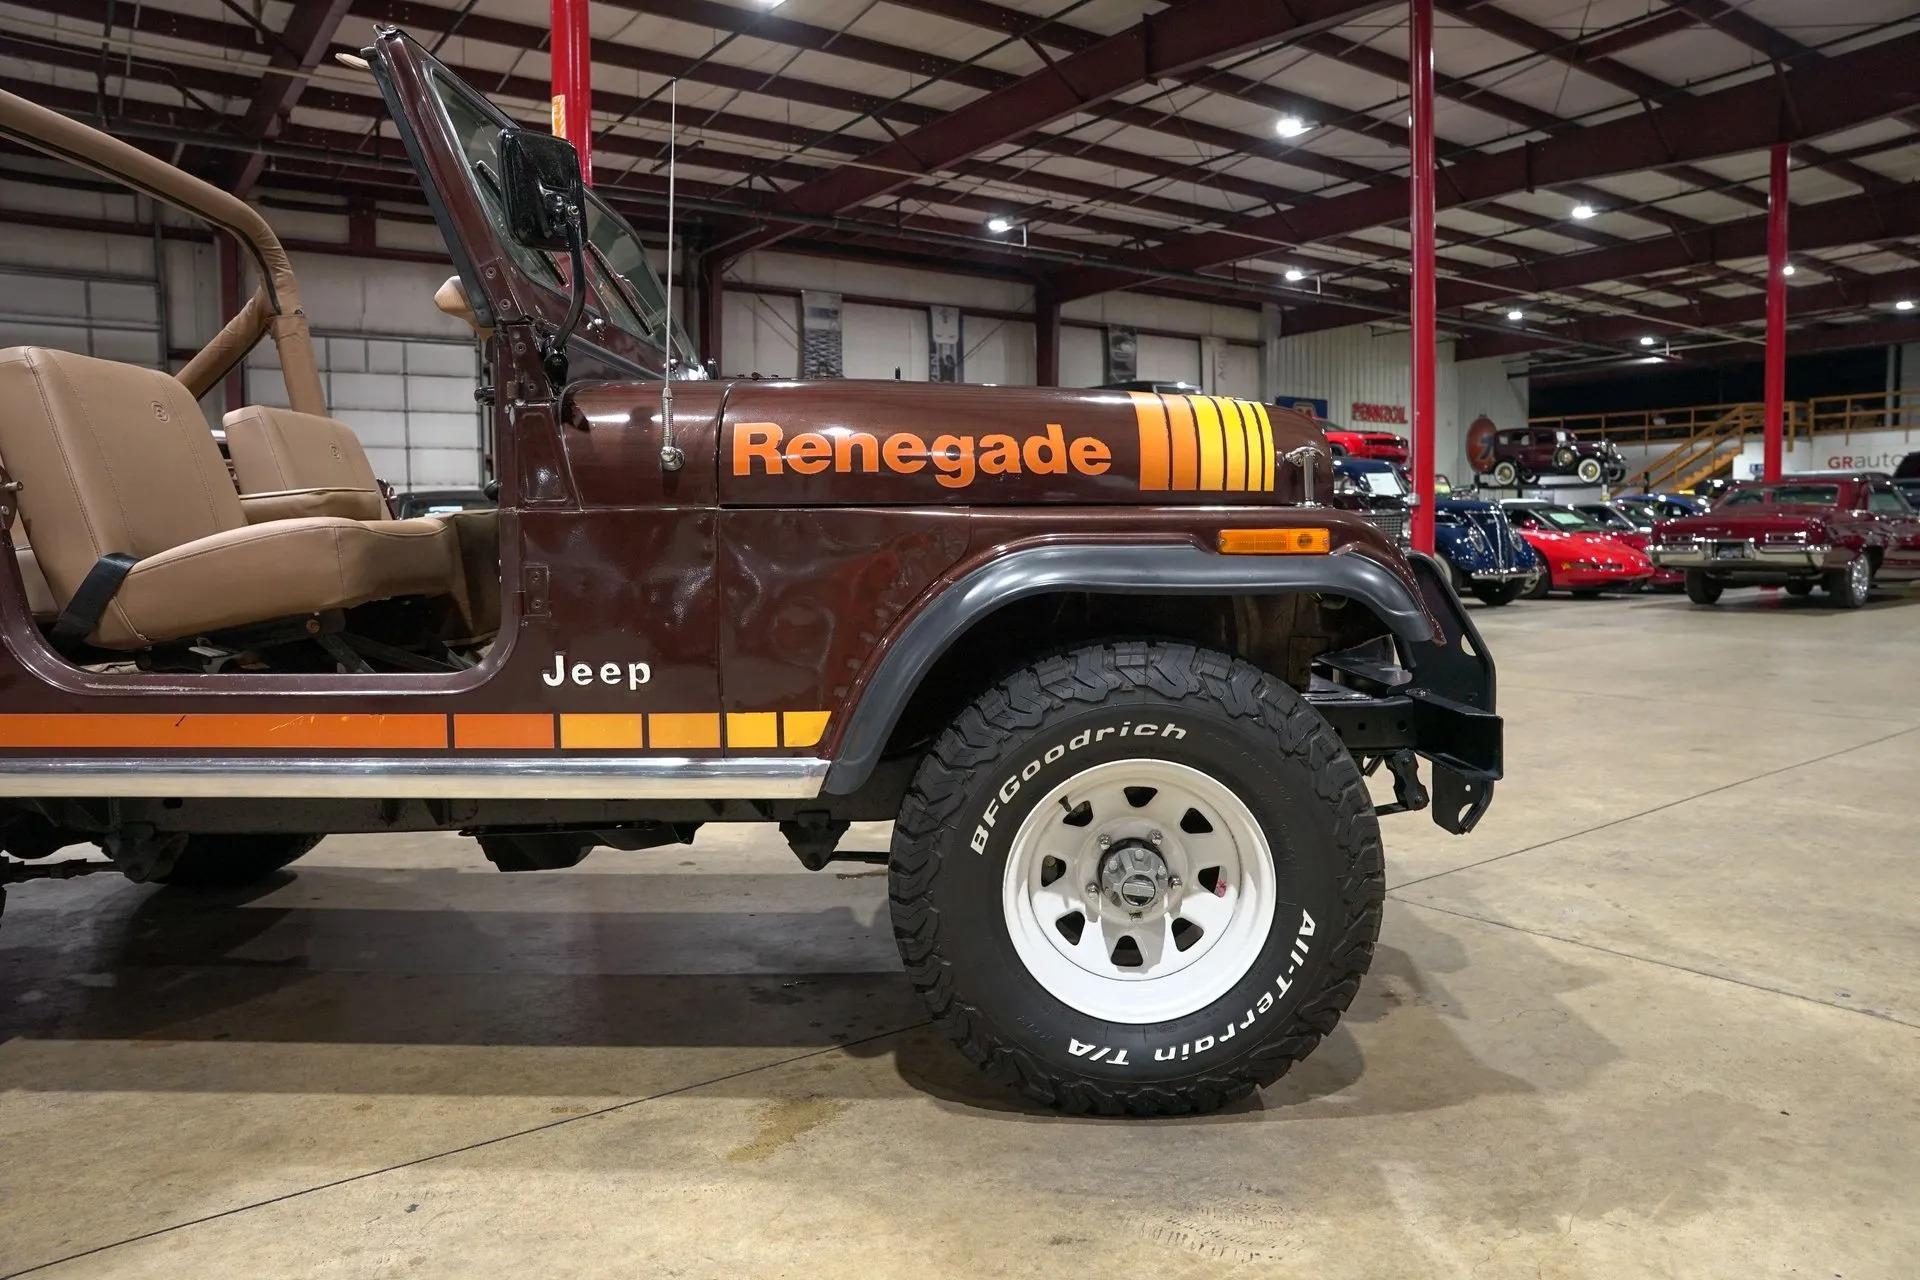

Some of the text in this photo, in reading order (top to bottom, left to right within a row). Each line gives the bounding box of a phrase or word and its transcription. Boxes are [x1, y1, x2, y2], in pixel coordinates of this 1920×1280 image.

[733, 422, 1112, 488] Renegade
[542, 653, 651, 691] Jeep
[970, 721, 1187, 856] BFGoodrich
[1067, 909, 1316, 1066] All-Terrain T/A
